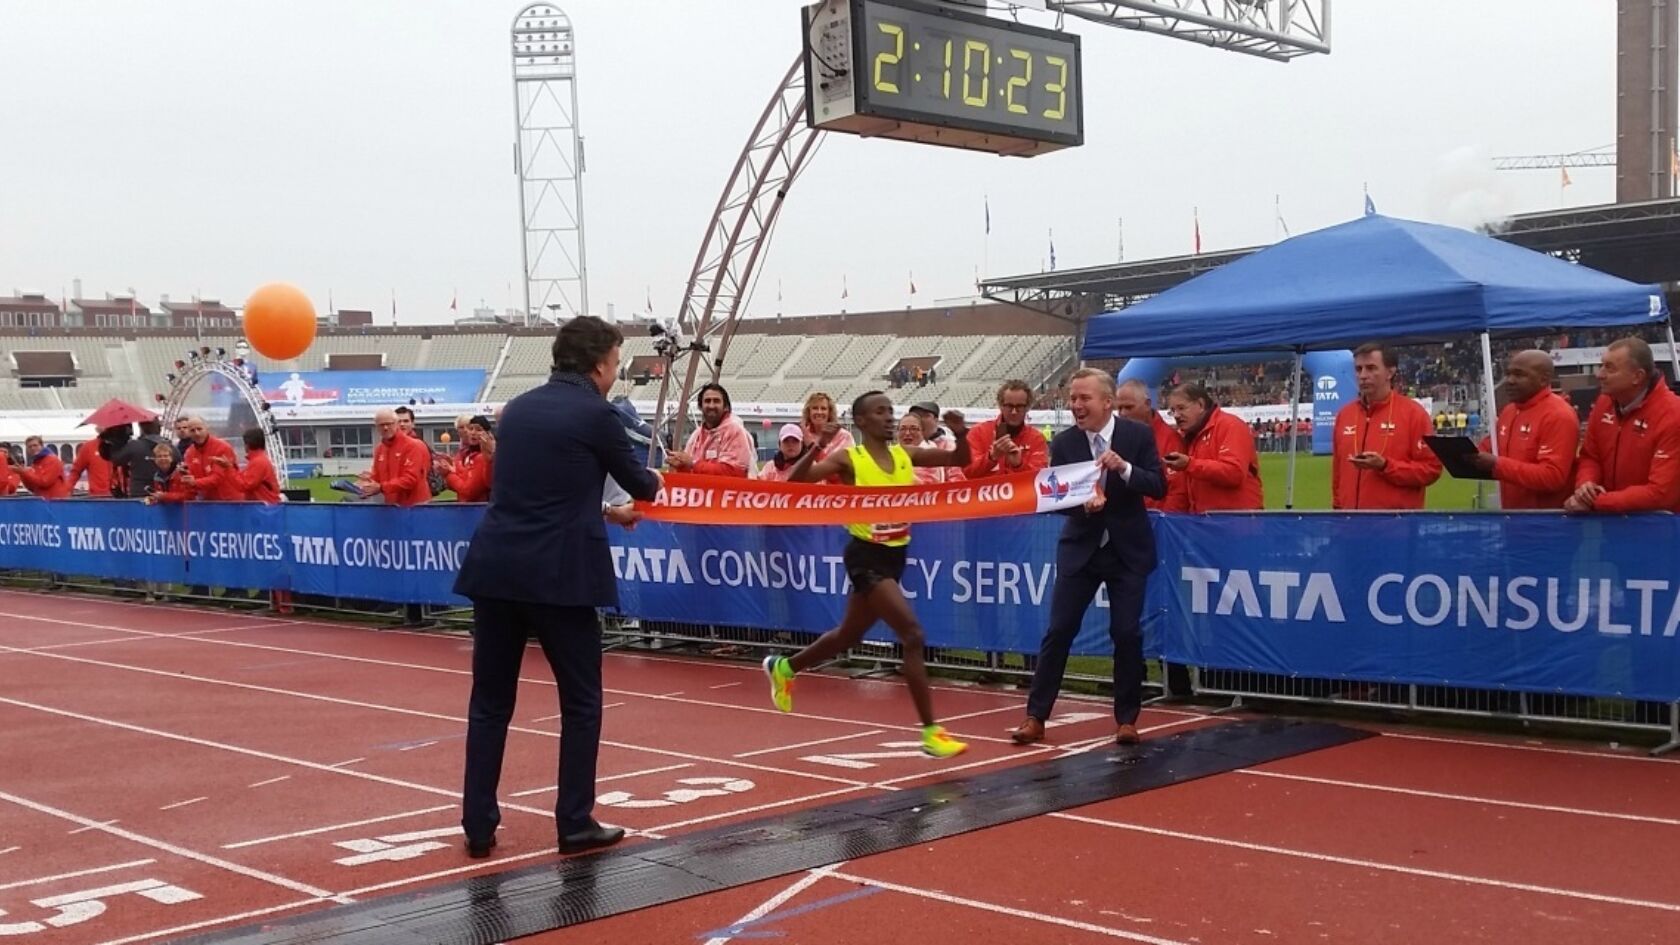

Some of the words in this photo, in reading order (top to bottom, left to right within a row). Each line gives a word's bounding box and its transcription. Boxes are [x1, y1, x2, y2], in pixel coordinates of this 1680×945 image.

[875, 23, 1068, 120] 2:10:23
[1315, 392, 1340, 401] TATA
[652, 487, 714, 508] ABDI
[720, 490, 792, 509] FROM
[795, 489, 939, 509] AMSTERDAM
[946, 487, 972, 505] TO
[977, 482, 1014, 502] RIO
[13, 523, 62, 548] SERVICES
[68, 526, 105, 551] TATA
[108, 527, 207, 557] CONSULTANCY
[209, 531, 283, 561] SERVICES
[291, 535, 339, 566] TATA
[343, 537, 471, 571] CONSULTANC
[609, 546, 694, 584] TATA
[1181, 566, 1346, 623] TATA
